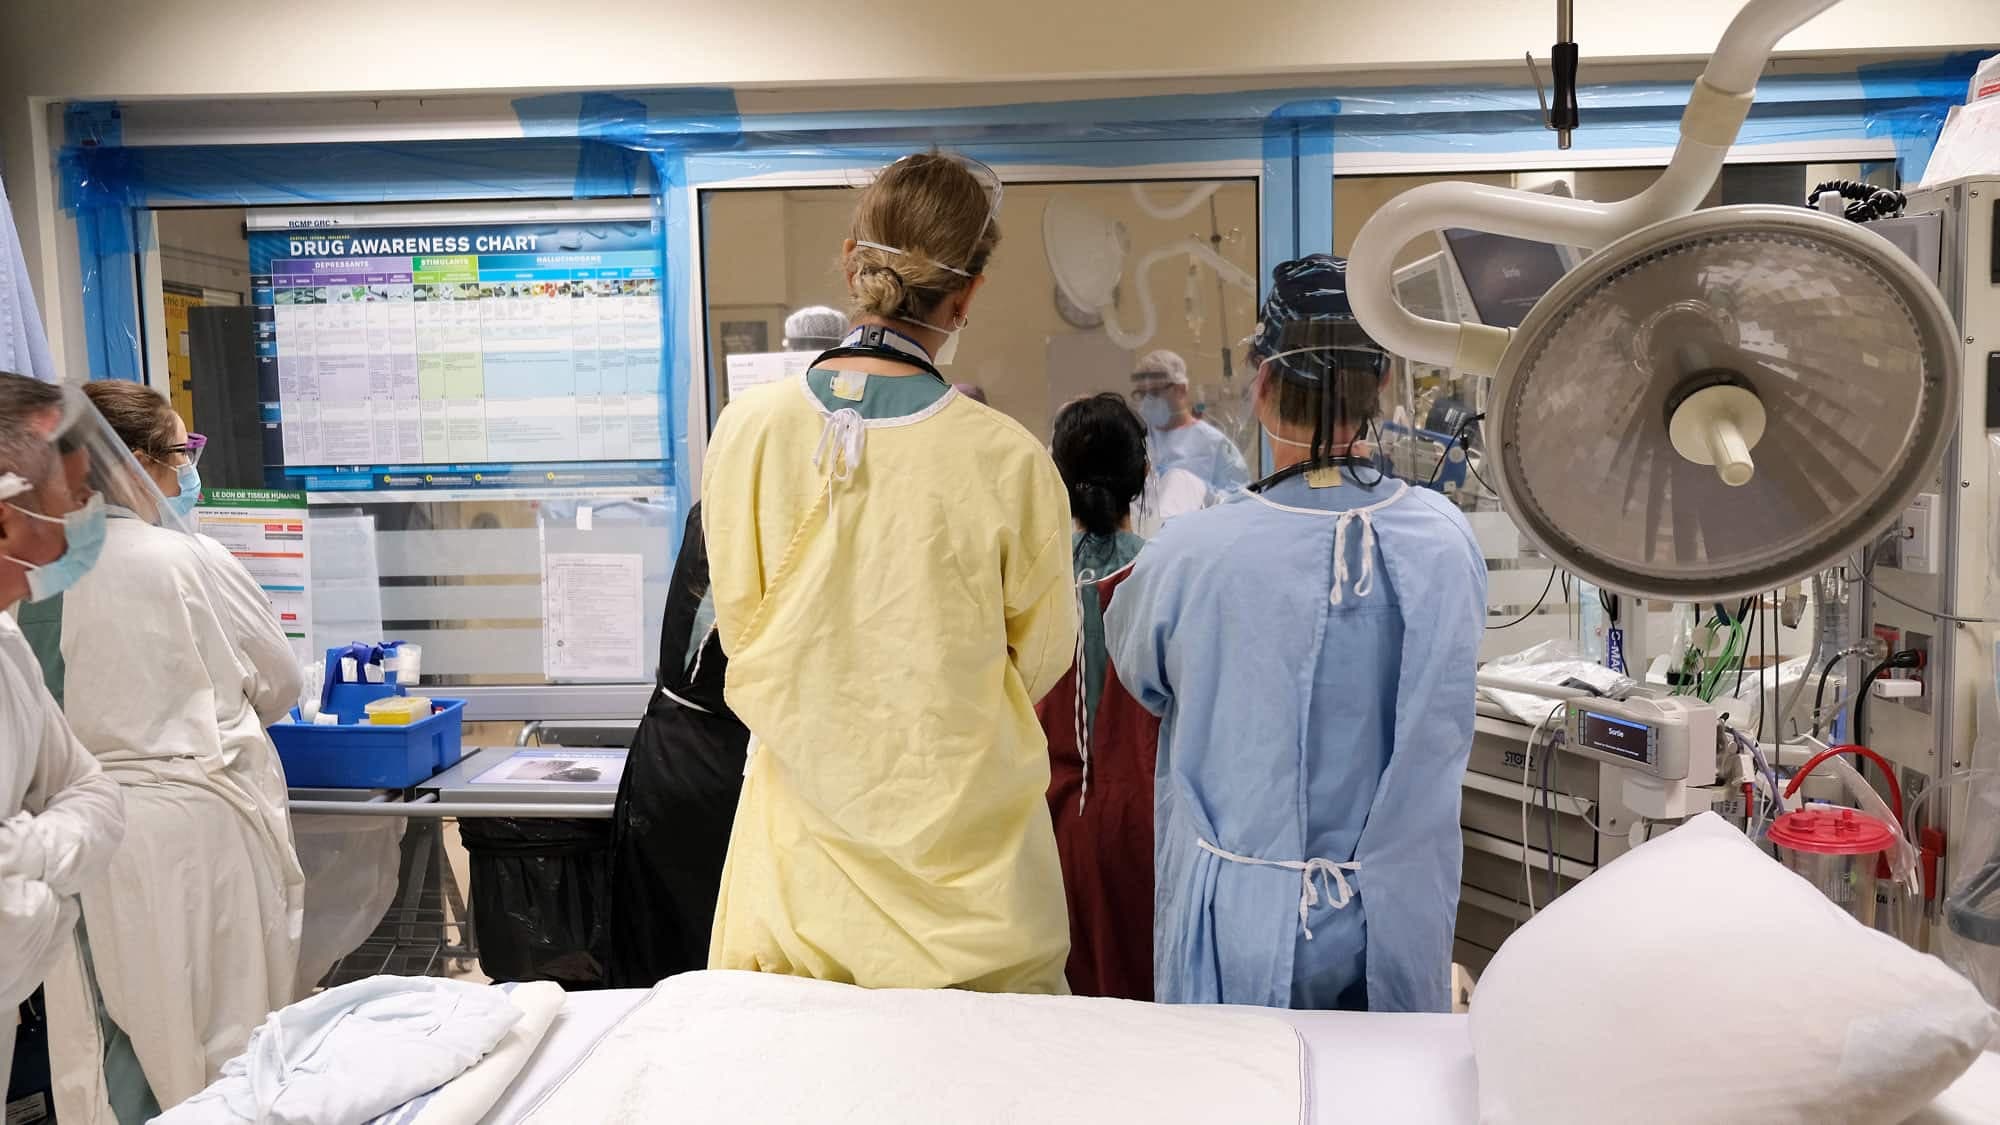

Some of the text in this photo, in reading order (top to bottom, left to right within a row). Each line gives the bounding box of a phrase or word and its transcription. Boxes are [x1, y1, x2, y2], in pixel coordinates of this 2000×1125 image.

[290, 240, 345, 256] DRUG
[350, 236, 470, 255] AWARENESS
[476, 235, 538, 252] CHART
[315, 260, 369, 269] DEPRESSANTS
[421, 258, 469, 266] STIMULANTS
[212, 491, 221, 499] LE
[221, 491, 236, 499] DON
